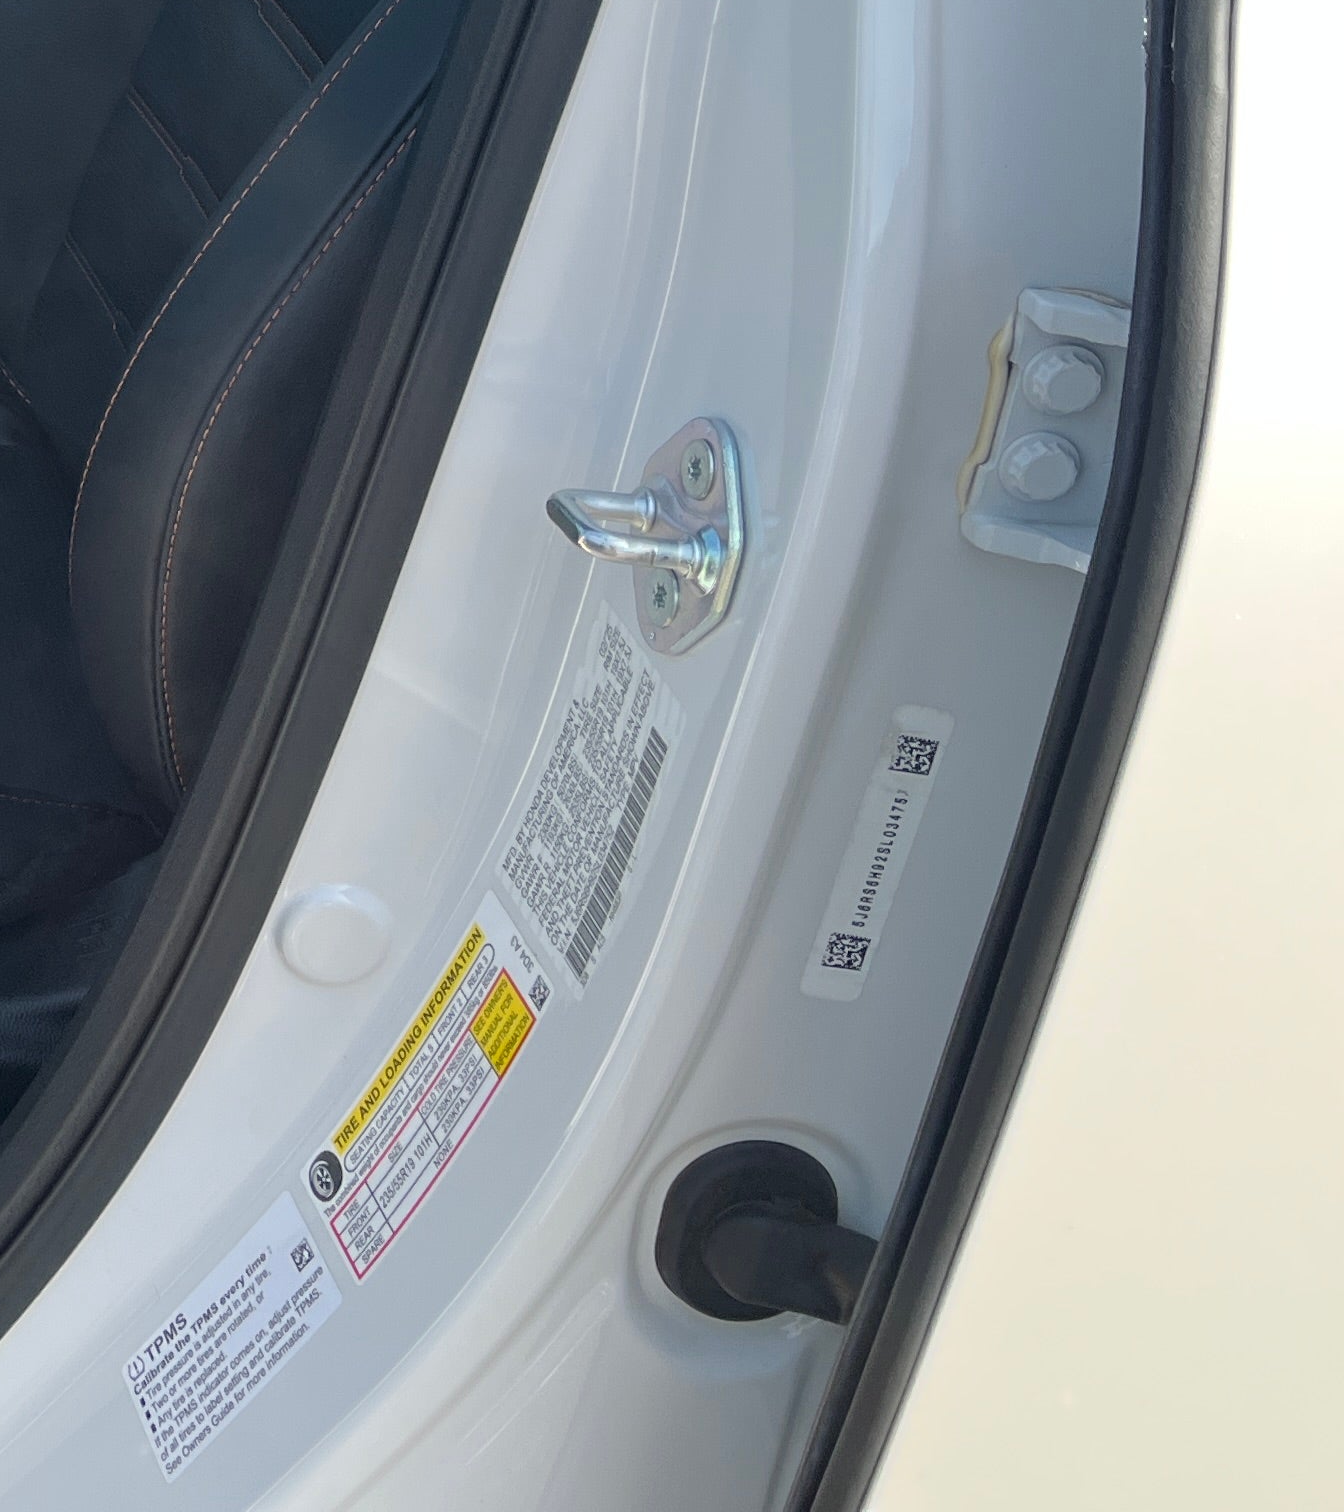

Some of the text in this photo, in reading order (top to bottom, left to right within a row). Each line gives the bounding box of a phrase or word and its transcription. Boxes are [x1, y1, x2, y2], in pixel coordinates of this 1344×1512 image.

[507, 786, 554, 883] MANUFACTURING
[549, 770, 560, 791] OF
[576, 695, 590, 722] LLC
[514, 825, 526, 847] BY
[522, 785, 544, 830] HONDA
[539, 707, 576, 791] DEVELOPMENT
[571, 696, 580, 710] &
[538, 735, 618, 929] FEDERAL MOTOR VEHICLE SAFETY
[333, 926, 483, 1153] TIRE AND LOADING INFORMATION
[349, 1124, 377, 1167] SEATING
[374, 1085, 405, 1131] CAPACITY
[407, 1048, 430, 1081] TOTAL
[436, 1003, 458, 1037] FRONT
[455, 996, 463, 1008] 2
[465, 960, 485, 990] REAR
[481, 953, 489, 965] 3
[472, 1014, 486, 1037] SEE
[479, 991, 513, 1048] MANUAL FOR
[486, 1008, 518, 1059] ADDITIONAL
[494, 1011, 530, 1072] INFORMATION
[342, 1033, 474, 1224] TIRE SIZE COLD TIRE PRESSURE
[347, 1203, 371, 1240] FRONT
[378, 1154, 416, 1211] 235/55R19
[413, 1131, 433, 1162] 101H
[353, 1221, 375, 1254] REAR
[361, 1137, 454, 1267] SPARE NONE
[132, 1249, 267, 1397] Calibrate the TPMS every time
[143, 1310, 188, 1365] TPMS
[145, 1378, 162, 1402] Tire
[161, 1346, 195, 1388] pressure
[192, 1337, 202, 1352] is
[199, 1303, 234, 1346] adjusted
[231, 1296, 241, 1311] in
[239, 1281, 257, 1304] any
[150, 1390, 169, 1416] Two
[167, 1382, 179, 1398] or
[176, 1363, 197, 1388] more
[195, 1343, 214, 1367] tires
[212, 1329, 228, 1350] are
[254, 1289, 266, 1305] or
[153, 1435, 162, 1449] If
[160, 1422, 175, 1443] the
[172, 1396, 198, 1429] TPMS
[196, 1363, 231, 1404] indicator
[228, 1338, 255, 1371] comes
[265, 1298, 293, 1332] adjust
[289, 1265, 325, 1306] pressure
[155, 1404, 174, 1429] Any
[171, 1391, 186, 1412] tire
[184, 1383, 193, 1398] is
[158, 1445, 170, 1463] of
[167, 1436, 179, 1453] all
[177, 1418, 196, 1443] tires
[194, 1409, 205, 1425] to
[203, 1389, 224, 1416] label
[221, 1363, 251, 1399] setting
[246, 1347, 265, 1370] and
[261, 1313, 297, 1354] calibrate
[164, 1451, 183, 1476] See
[180, 1420, 212, 1459] Owners
[209, 1396, 235, 1428] Guide
[232, 1384, 246, 1404] for
[244, 1365, 267, 1392] more
